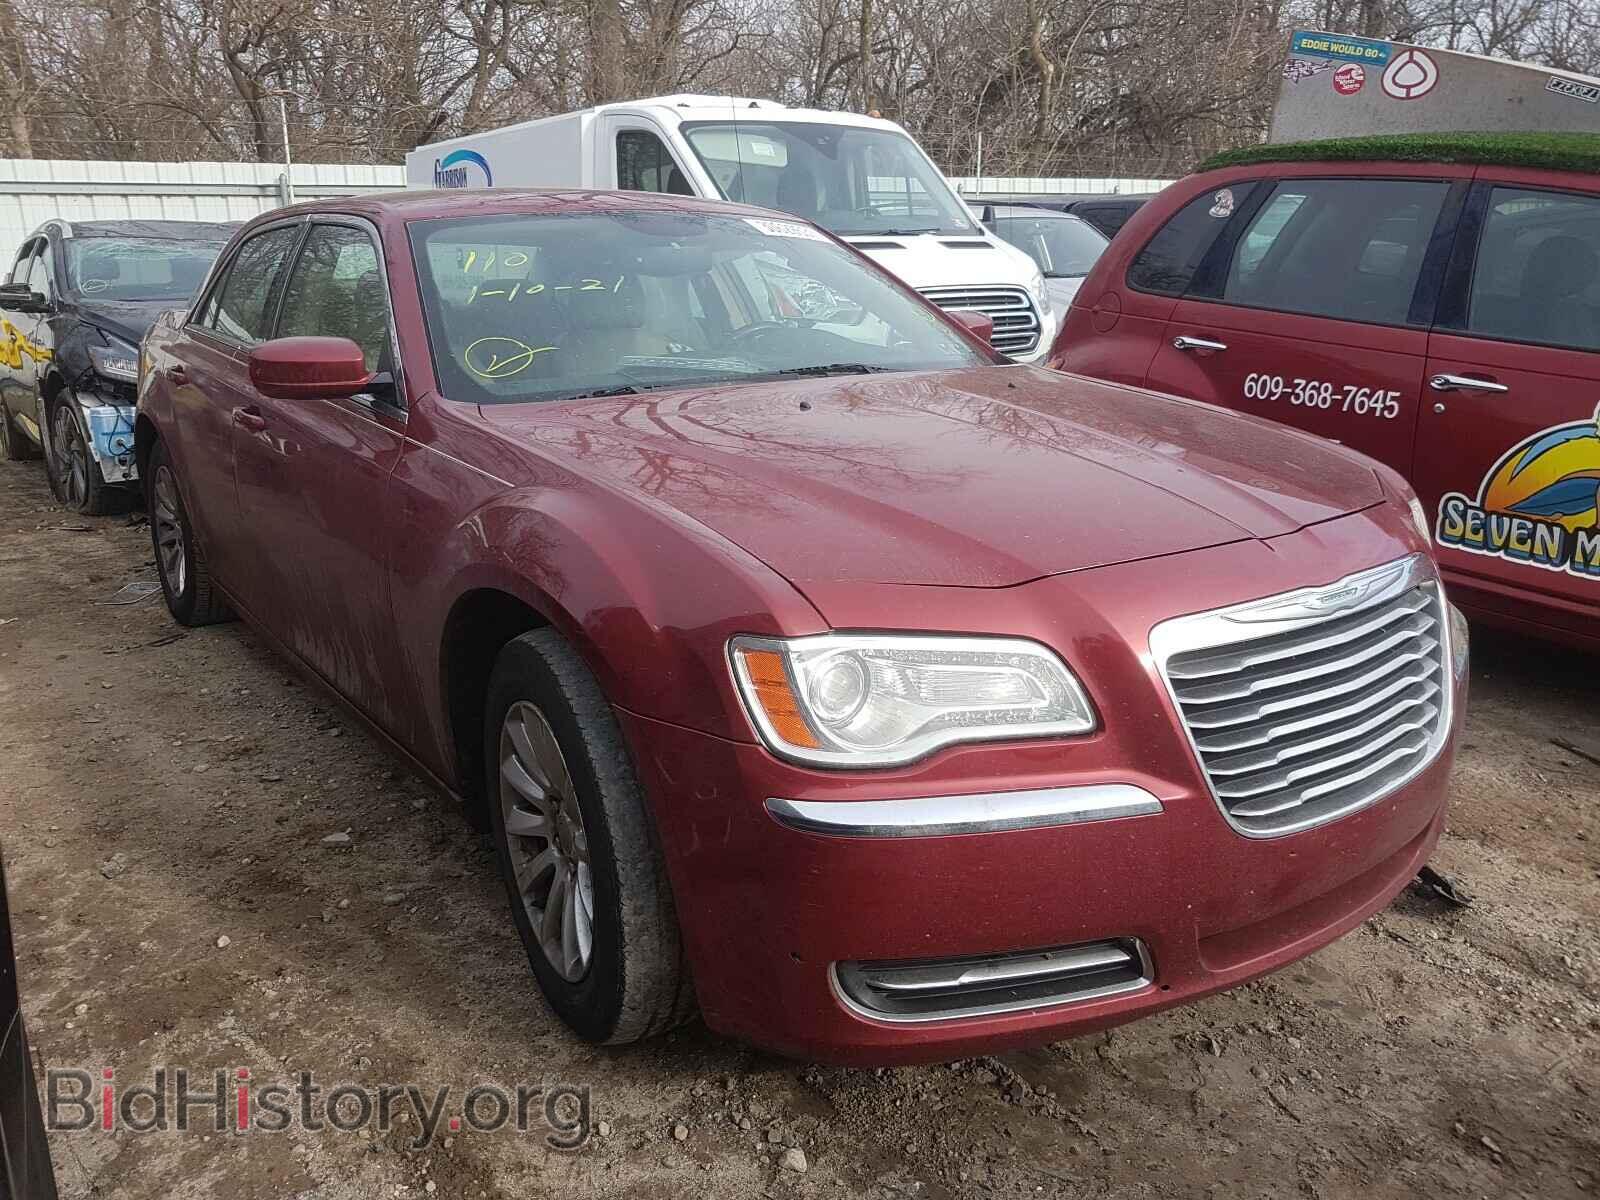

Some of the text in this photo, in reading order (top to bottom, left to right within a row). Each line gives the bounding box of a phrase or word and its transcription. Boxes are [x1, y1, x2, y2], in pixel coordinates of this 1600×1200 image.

[1301, 39, 1379, 58] EDDIE WOULD GO
[464, 251, 528, 273] 110
[1244, 373, 1401, 419] 609-368-7645
[1443, 500, 1562, 562] SEVEN
